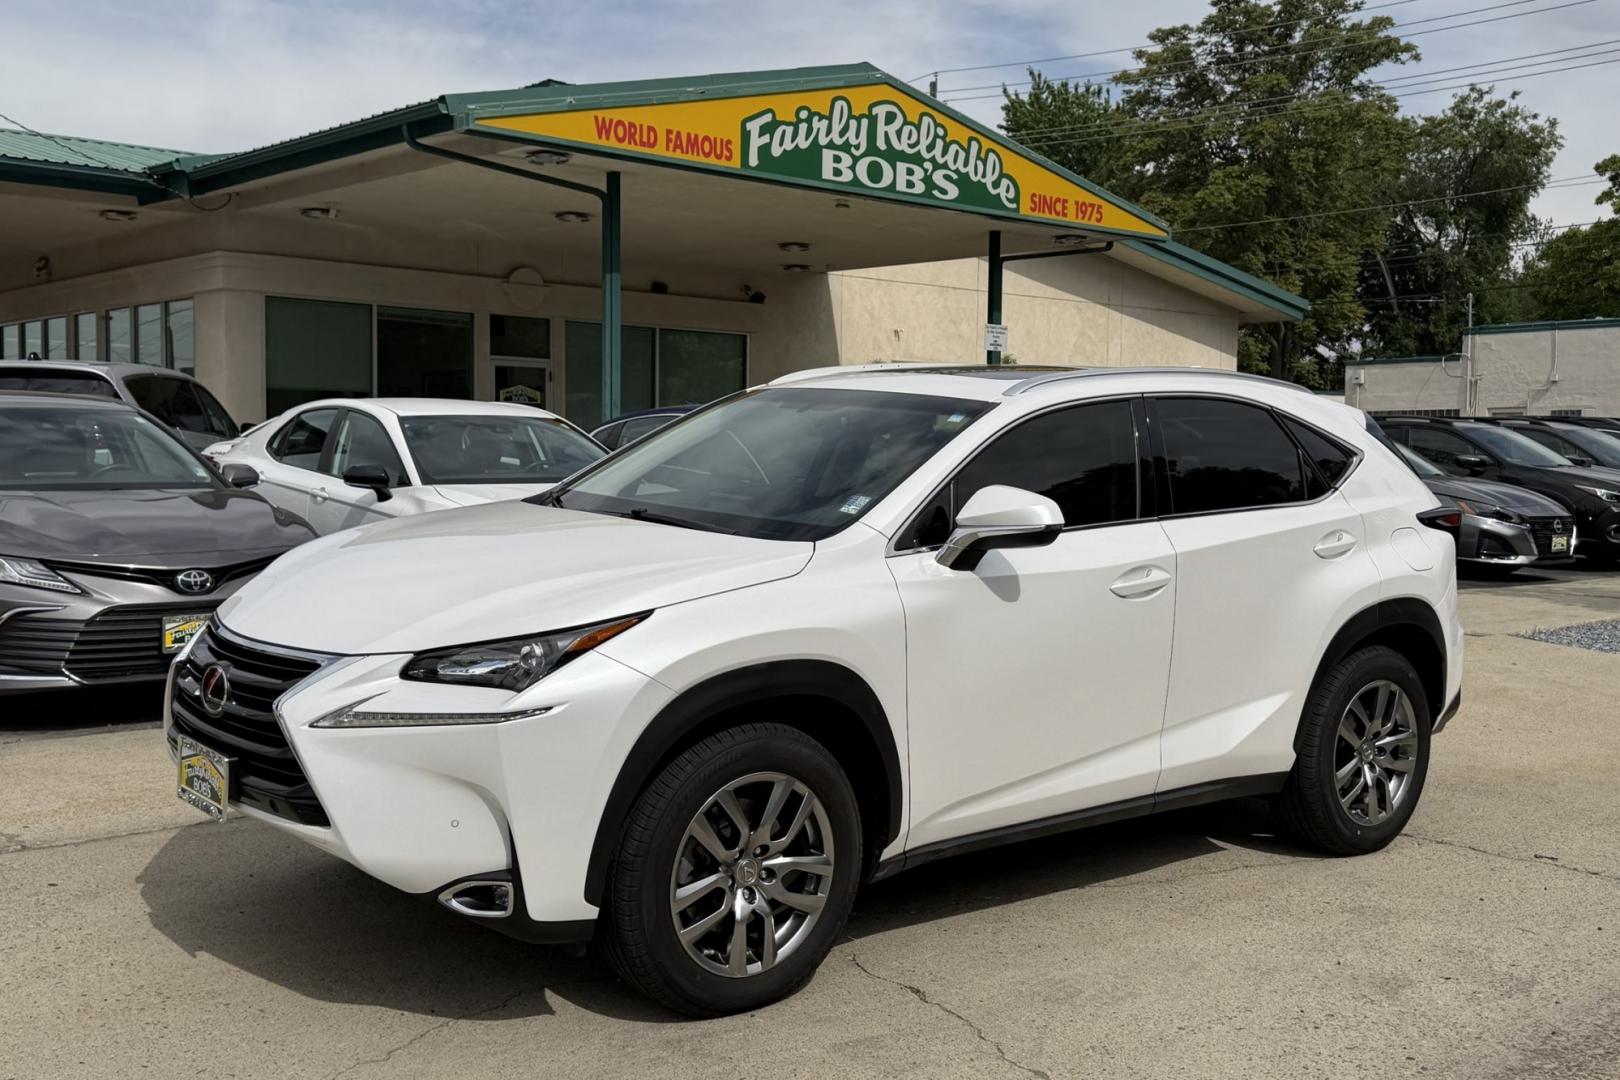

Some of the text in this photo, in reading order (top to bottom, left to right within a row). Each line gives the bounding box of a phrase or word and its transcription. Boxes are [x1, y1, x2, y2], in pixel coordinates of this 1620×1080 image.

[593, 114, 733, 162] WORLD FAMOUS
[745, 99, 1017, 209] Fairly Reliable
[821, 147, 960, 200] BOB'S
[1029, 192, 1103, 224] SINCE 1975
